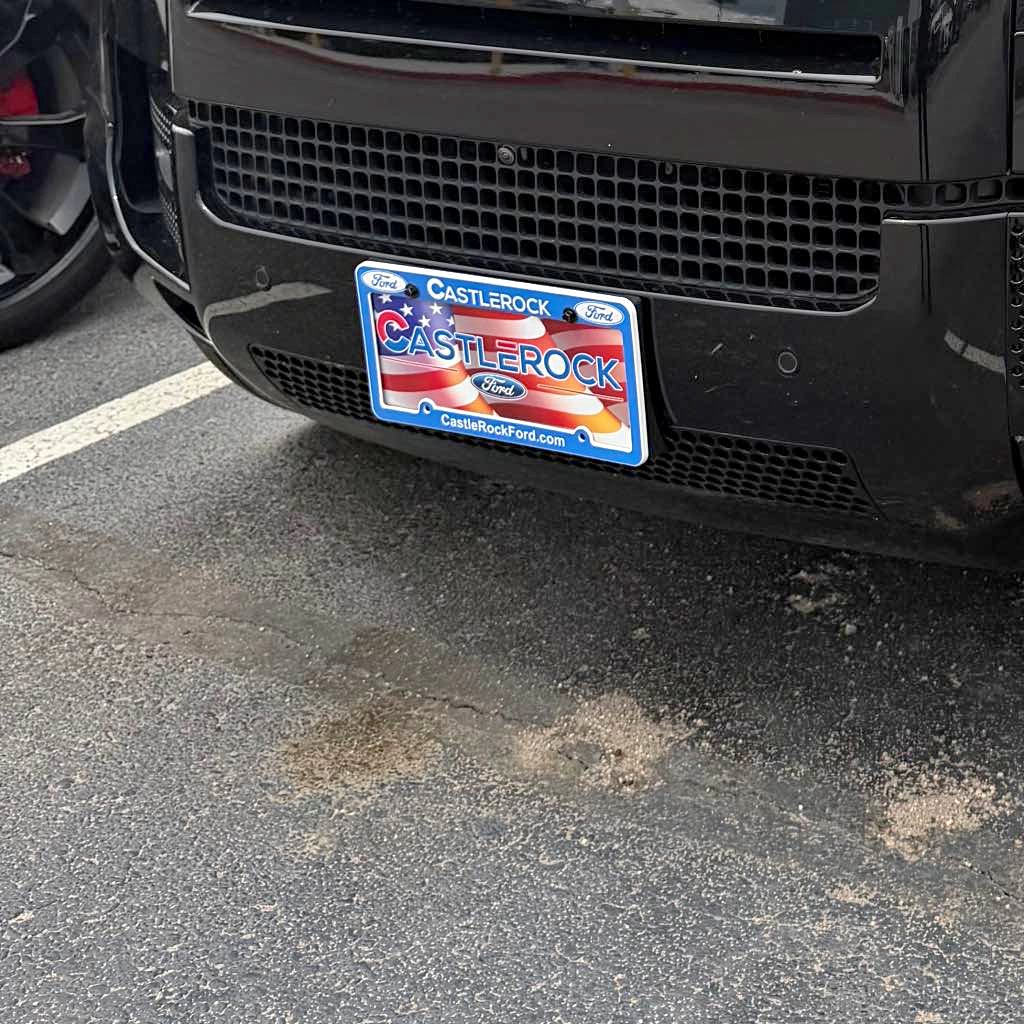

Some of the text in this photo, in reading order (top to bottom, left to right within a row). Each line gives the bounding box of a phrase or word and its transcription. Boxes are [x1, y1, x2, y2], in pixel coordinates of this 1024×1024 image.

[370, 273, 398, 290] Ford
[426, 277, 552, 317] CASTLEROCK
[584, 304, 614, 322] Ford
[375, 309, 624, 391] CASTLEROCK
[480, 375, 516, 397] Ford
[440, 413, 567, 448] CastleRockFord.com
